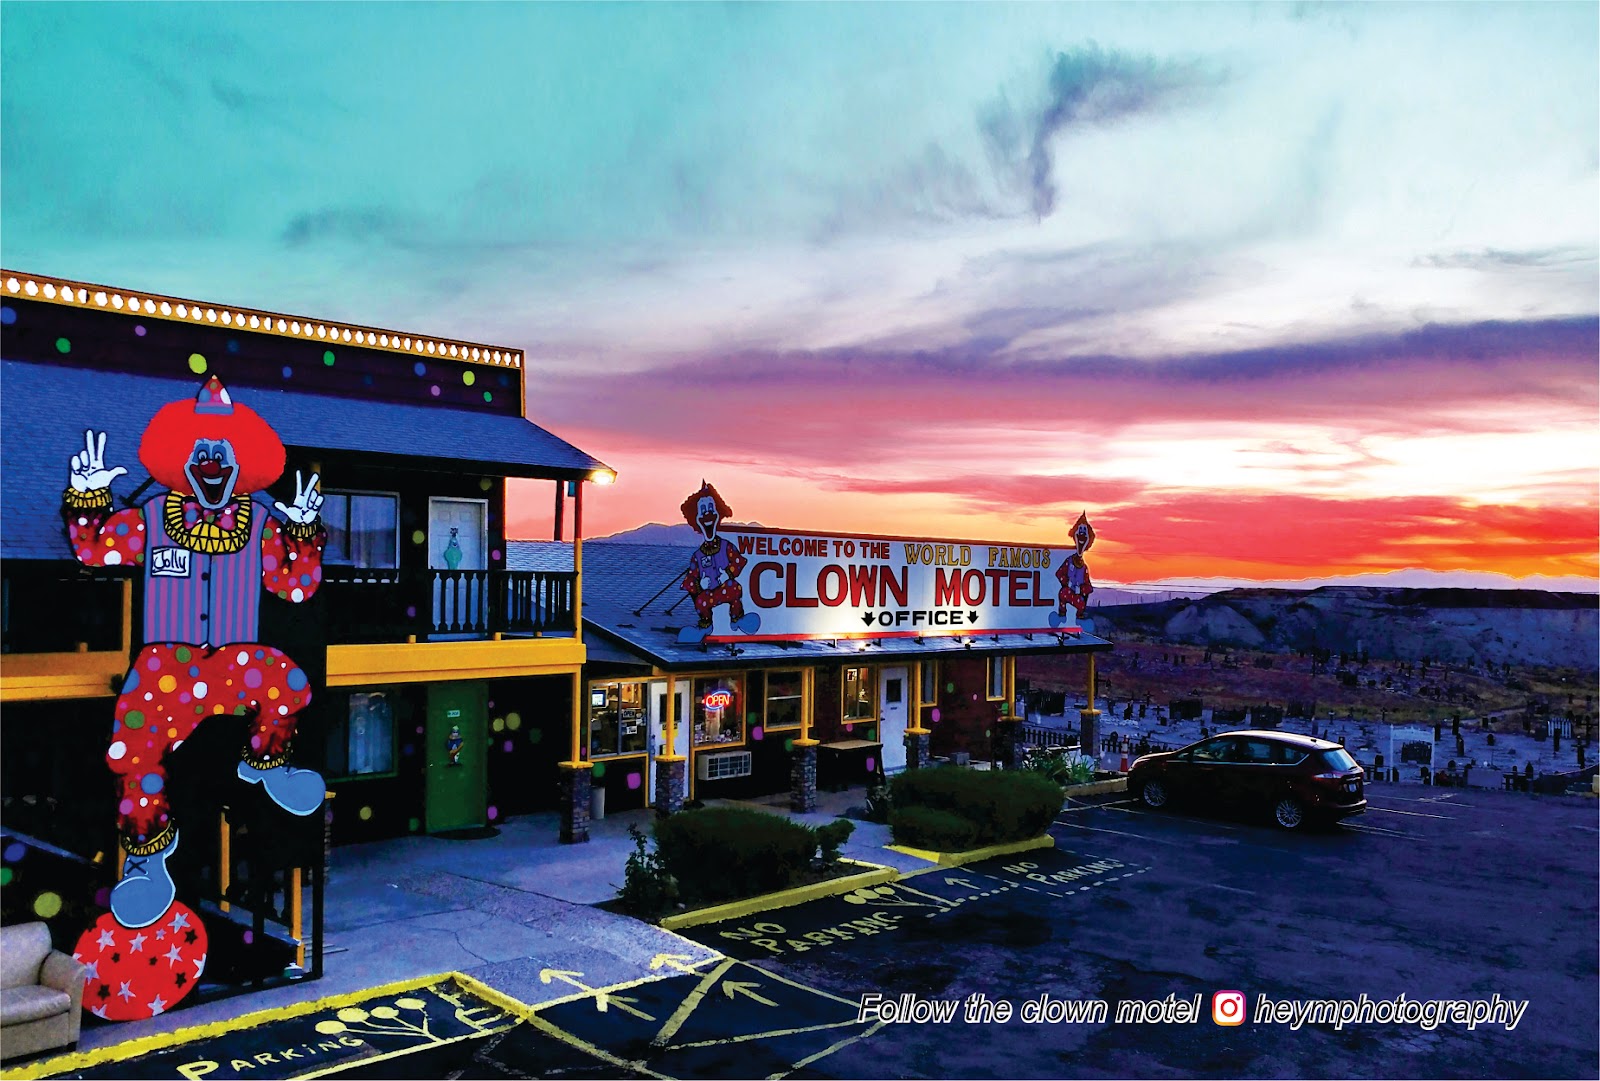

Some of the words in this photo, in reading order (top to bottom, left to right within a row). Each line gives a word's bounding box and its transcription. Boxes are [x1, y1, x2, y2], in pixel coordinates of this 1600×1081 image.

[152, 548, 188, 574] Jolly
[737, 535, 828, 558] WELCOME
[832, 540, 856, 558] TO
[859, 541, 891, 560] THE
[904, 543, 972, 566] WORLD
[987, 546, 1051, 569] FAMOUS
[748, 561, 908, 609] CLOWN
[934, 567, 1055, 607] MOTEL
[878, 610, 964, 627] OFFICE
[705, 694, 731, 707] OPEN
[1002, 861, 1039, 875] NO
[1026, 860, 1125, 886] PARKING
[719, 922, 787, 941] NO
[750, 911, 904, 953] PARKING
